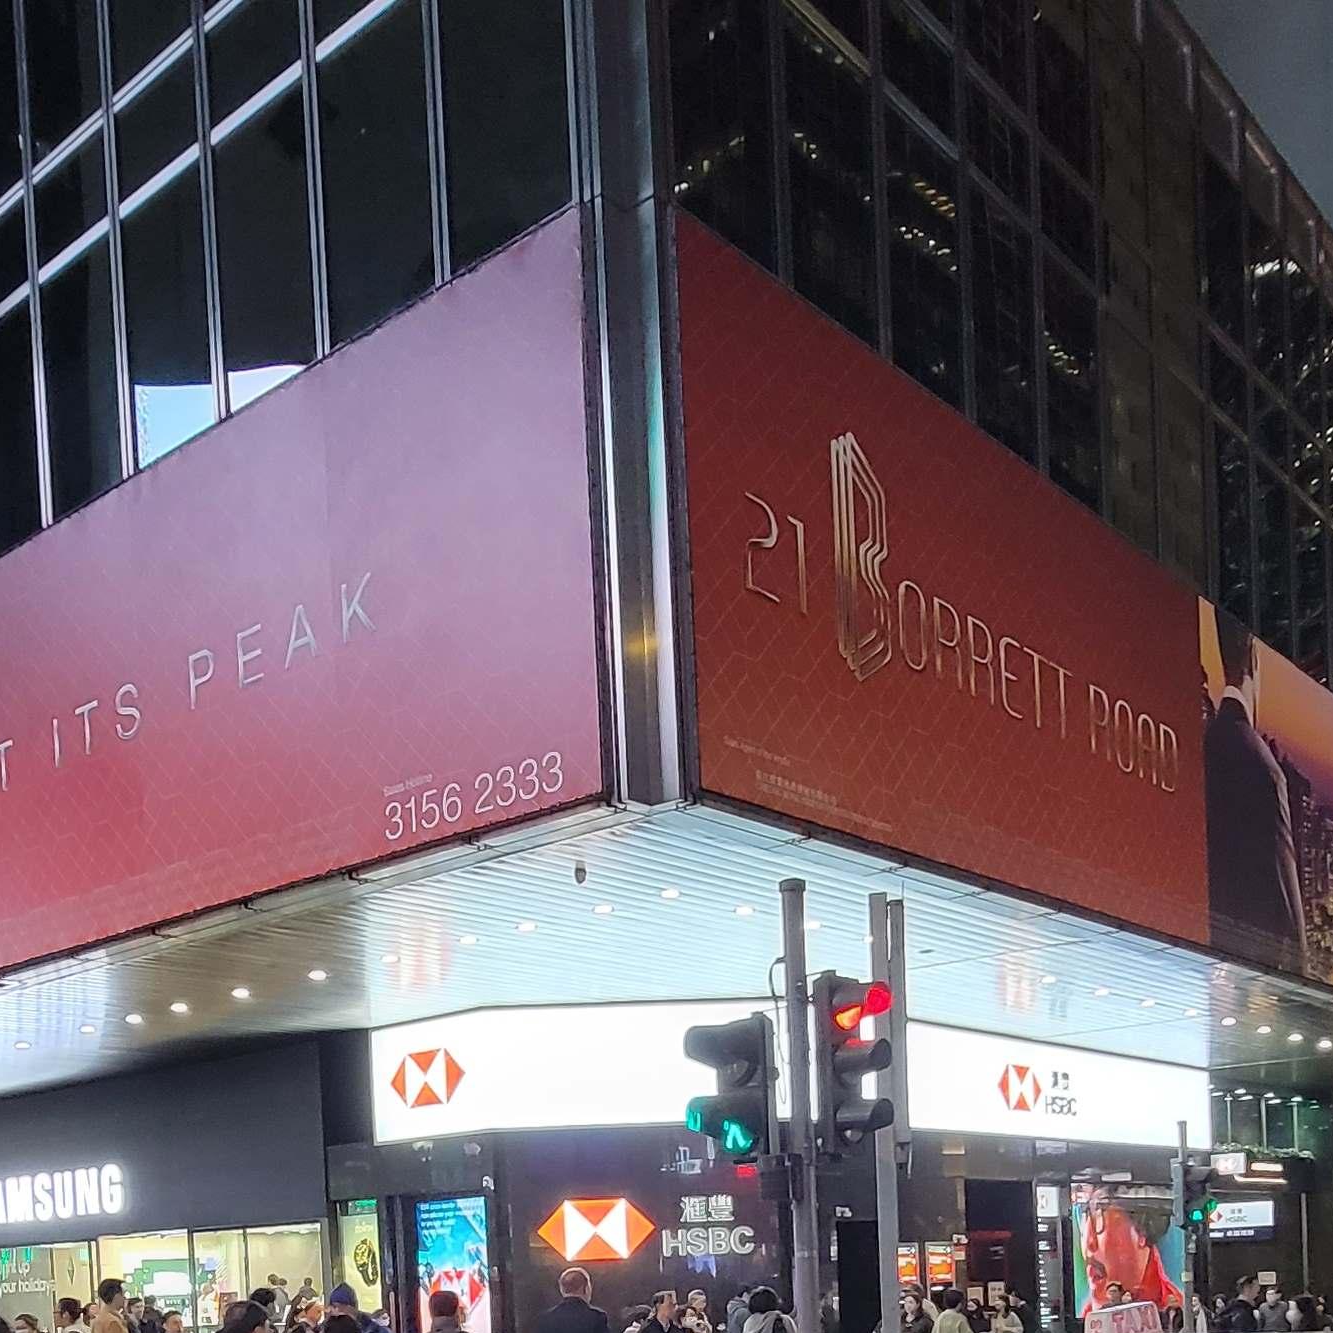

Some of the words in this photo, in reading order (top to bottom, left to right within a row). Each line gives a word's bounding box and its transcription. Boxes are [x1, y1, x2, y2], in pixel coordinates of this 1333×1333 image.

[52, 683, 142, 768] ITS
[188, 572, 377, 710] PEAK
[744, 490, 809, 615] 21
[1087, 683, 1179, 793] ROAD
[384, 782, 463, 841] 3156
[473, 750, 564, 815] 2333
[662, 1225, 756, 1258] HSBC
